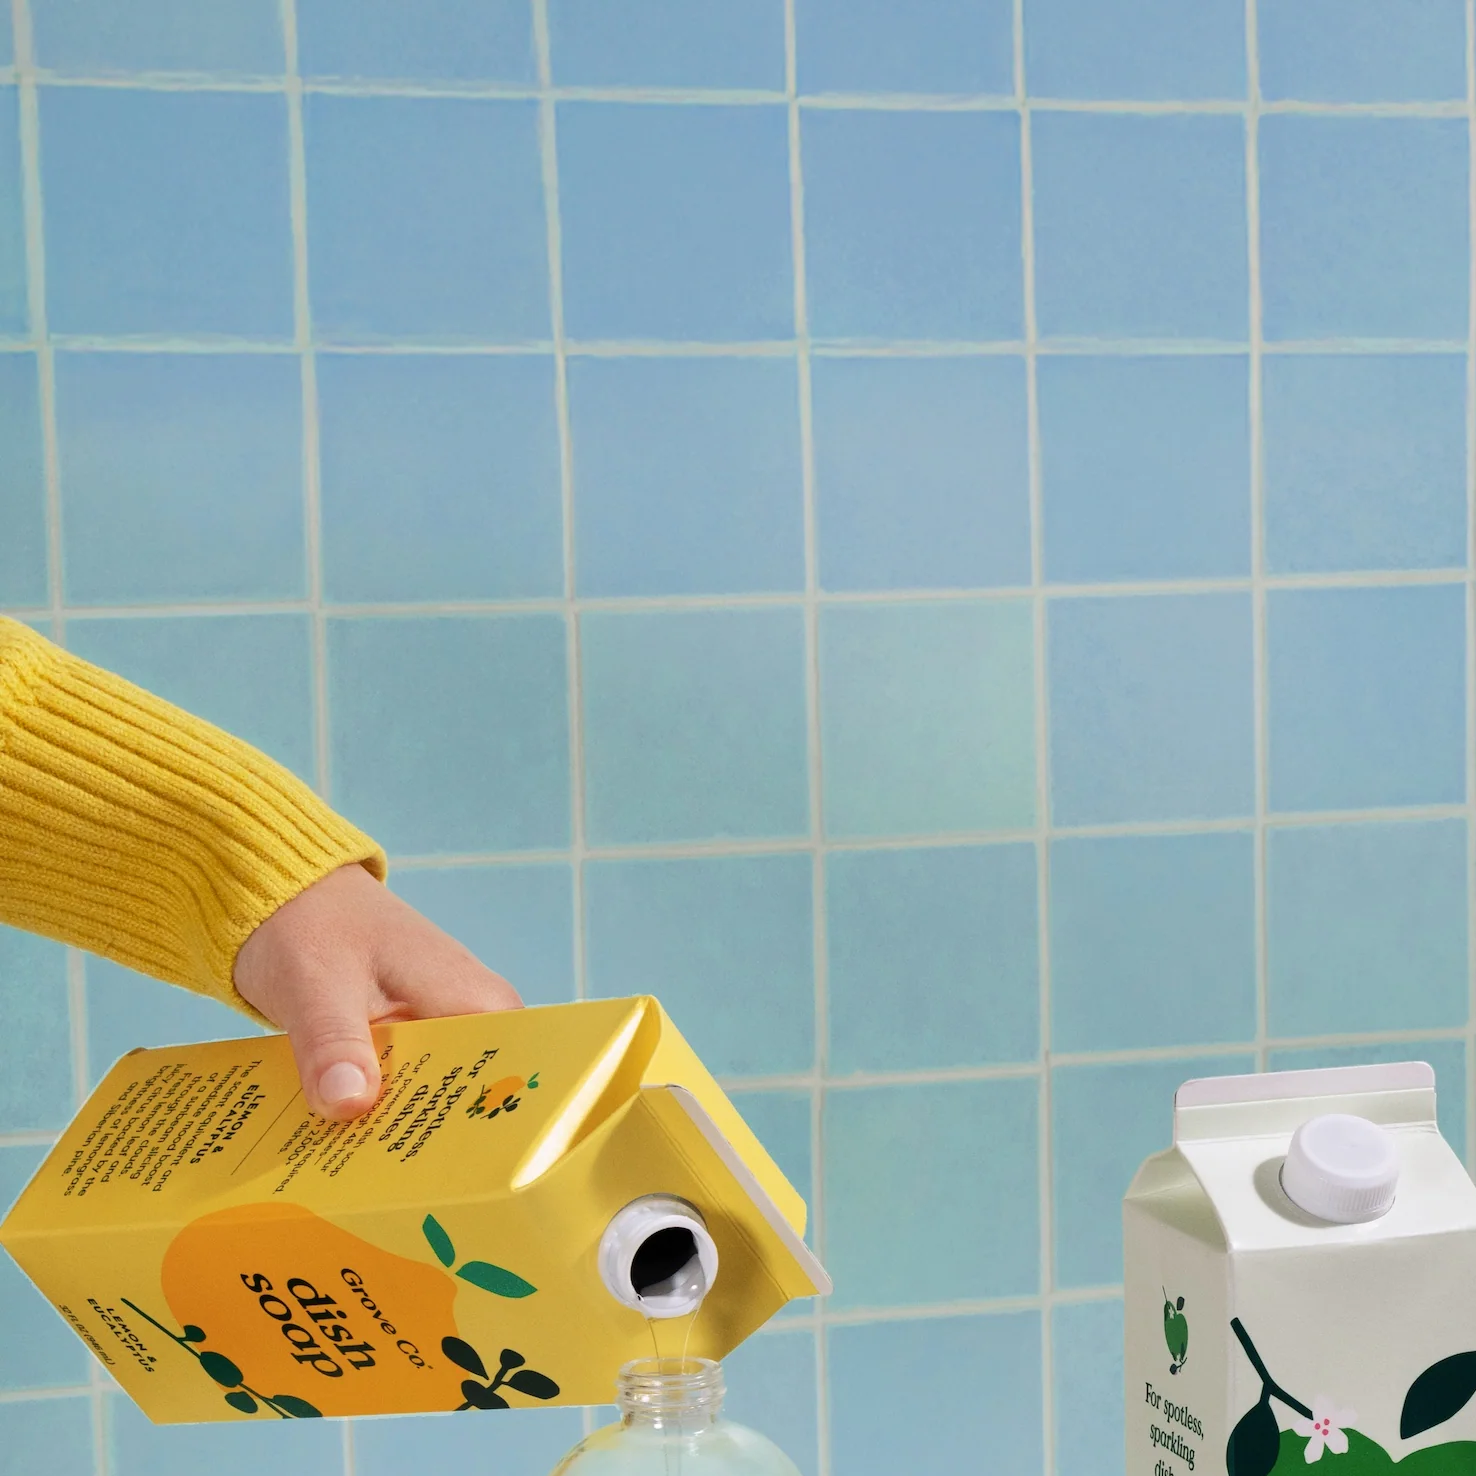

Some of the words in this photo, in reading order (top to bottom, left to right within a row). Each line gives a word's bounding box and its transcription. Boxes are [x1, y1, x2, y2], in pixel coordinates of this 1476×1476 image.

[240, 1059, 263, 1078] The
[380, 1045, 394, 1060] no
[412, 1053, 431, 1074] Our
[467, 1048, 499, 1079] For
[120, 1064, 173, 1115] brightness
[162, 1072, 193, 1099] Fresh
[196, 1085, 207, 1093] a
[206, 1072, 219, 1083] of
[391, 1062, 410, 1084] cuts
[117, 1081, 139, 1101] and
[135, 1086, 163, 1114] citrus
[164, 1075, 203, 1116] through
[192, 1065, 242, 1118] immediate
[215, 1080, 242, 1108] scent
[373, 1078, 412, 1124] powerful
[82, 1103, 122, 1147] Siberian
[109, 1118, 122, 1130] of
[135, 1101, 168, 1133] lemon
[157, 1095, 199, 1143] sunbeam
[190, 1084, 260, 1164] EUCALYPTUS
[222, 1094, 266, 1140] LEMON
[355, 1088, 393, 1129] through
[378, 1084, 429, 1142] dishes
[387, 1066, 463, 1152] sparkling
[400, 1085, 468, 1162] spotless,
[104, 1116, 141, 1156] backed
[148, 1118, 167, 1136] the
[166, 1120, 194, 1151] mood
[170, 1110, 217, 1166] equivalent
[277, 1120, 310, 1154] dishes.
[353, 1127, 374, 1148] dish
[118, 1135, 141, 1157] leaf
[118, 1139, 150, 1177] clouds.
[129, 1146, 160, 1180] slicing
[211, 1145, 224, 1153] &
[320, 1132, 357, 1173] 48-hour
[61, 1150, 84, 1177] pine.
[63, 1132, 114, 1197] lemongrass
[92, 1159, 109, 1173] by
[99, 1160, 120, 1183] and
[141, 1154, 171, 1186] boost
[152, 1169, 172, 1192] and
[272, 1148, 316, 1194] required.
[329, 1151, 354, 1177] soap
[77, 1176, 96, 1197] the
[340, 1267, 397, 1336] Grove
[86, 1298, 155, 1373] EUCALYPTUS
[106, 1307, 148, 1352] LEMON
[240, 1273, 344, 1378] soap
[287, 1277, 376, 1370] dish
[1145, 1381, 1162, 1410] For
[1163, 1399, 1204, 1441] spotless,
[1149, 1423, 1195, 1471] sparkling
